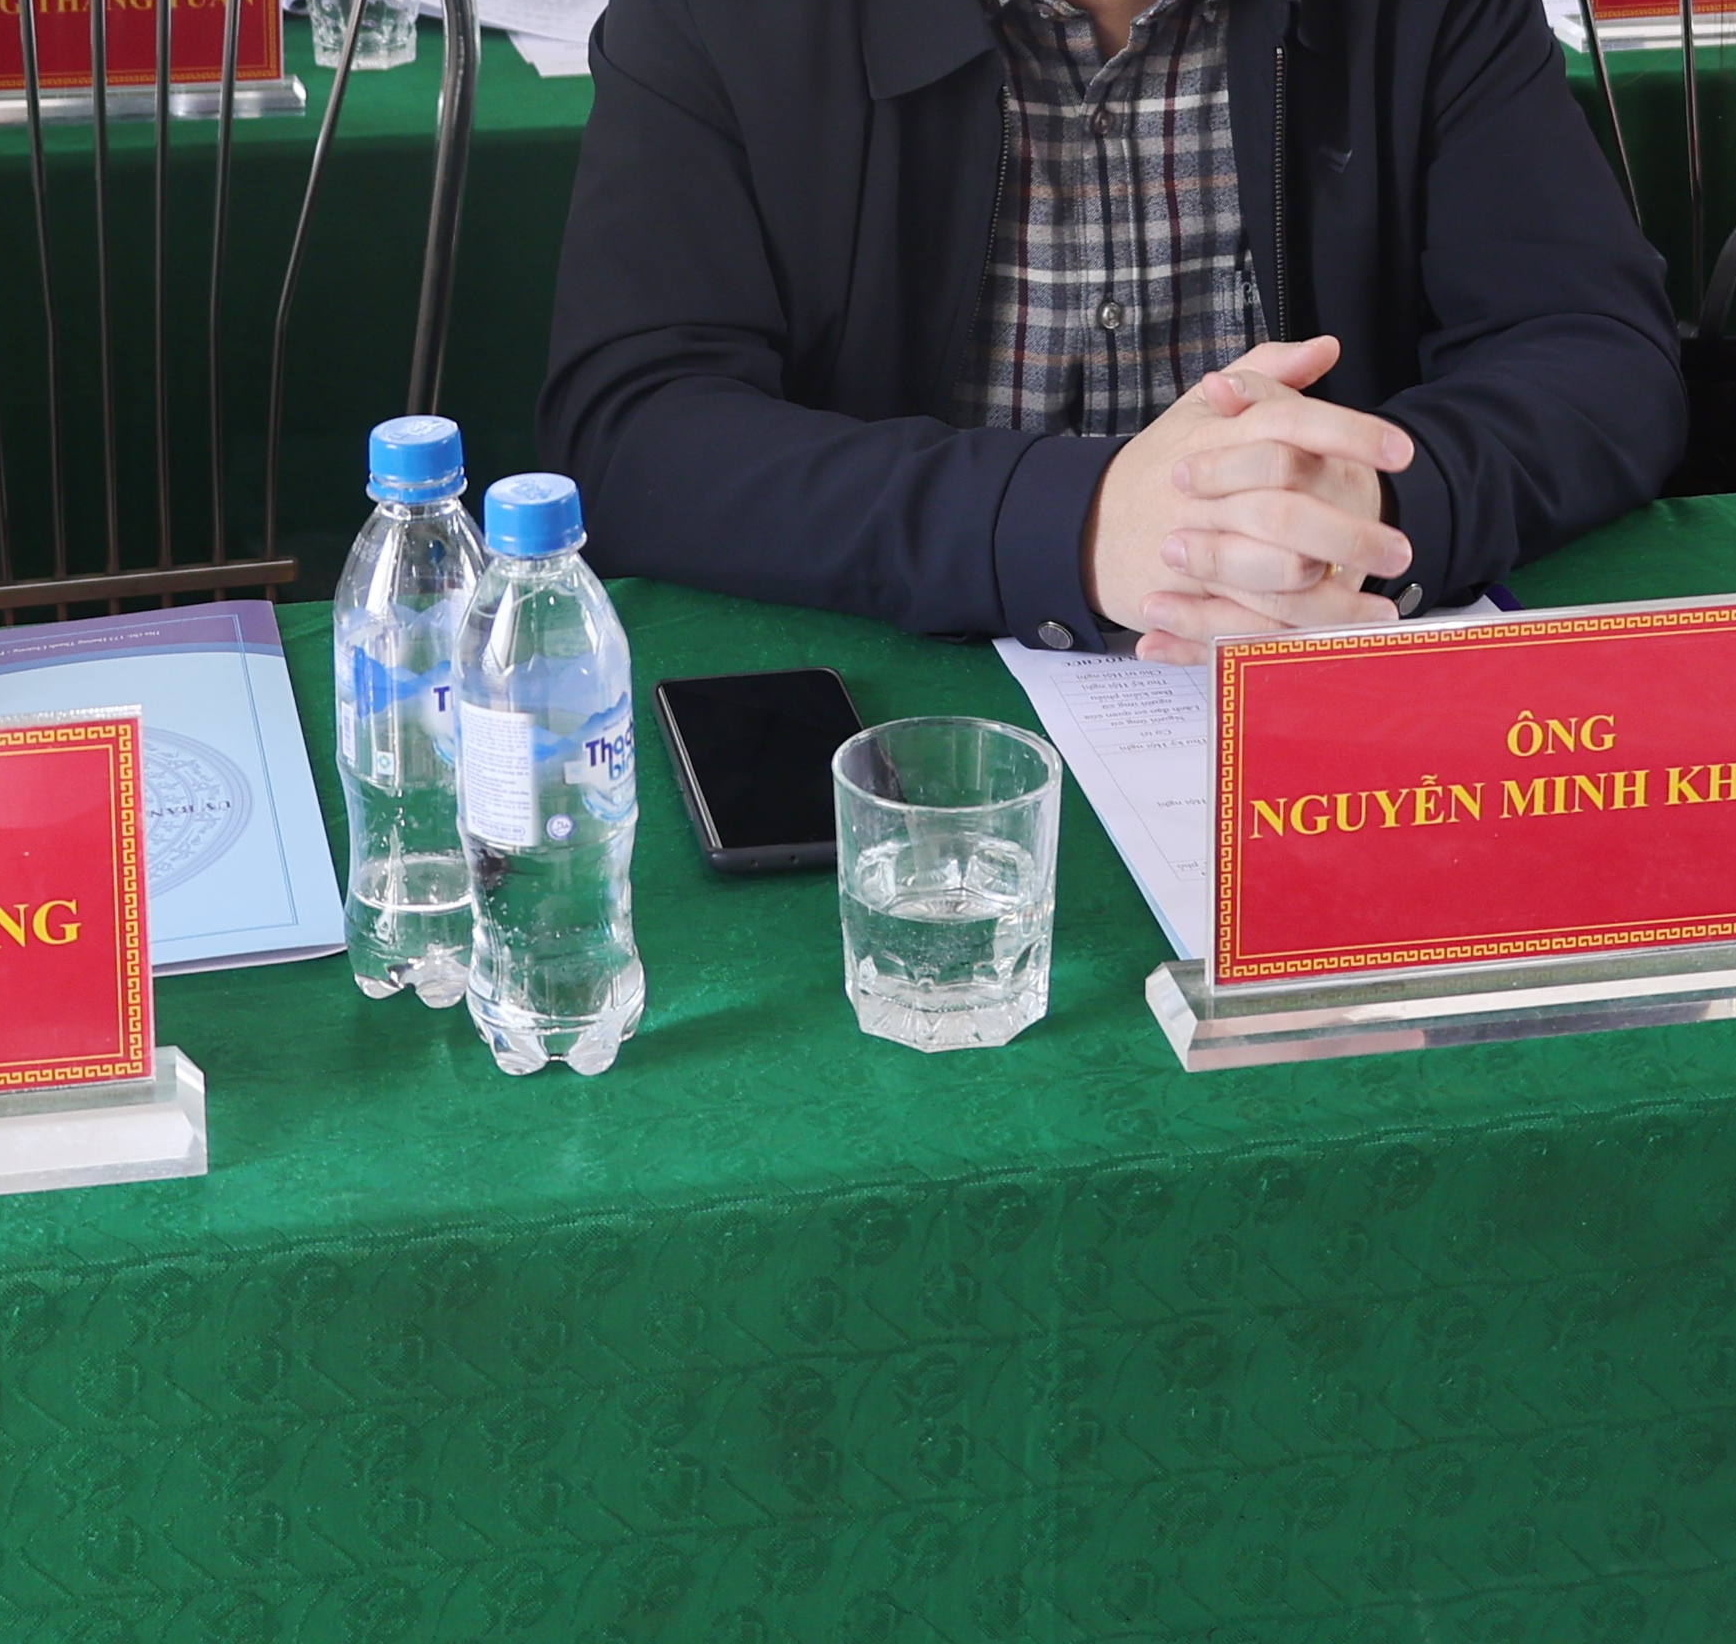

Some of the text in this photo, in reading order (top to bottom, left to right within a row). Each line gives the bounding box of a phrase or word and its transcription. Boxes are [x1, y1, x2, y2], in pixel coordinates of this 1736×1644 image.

[1506, 709, 1617, 758] ÔNG
[1248, 773, 1484, 838] NGUYỄN
[1498, 767, 1651, 820] MINH
